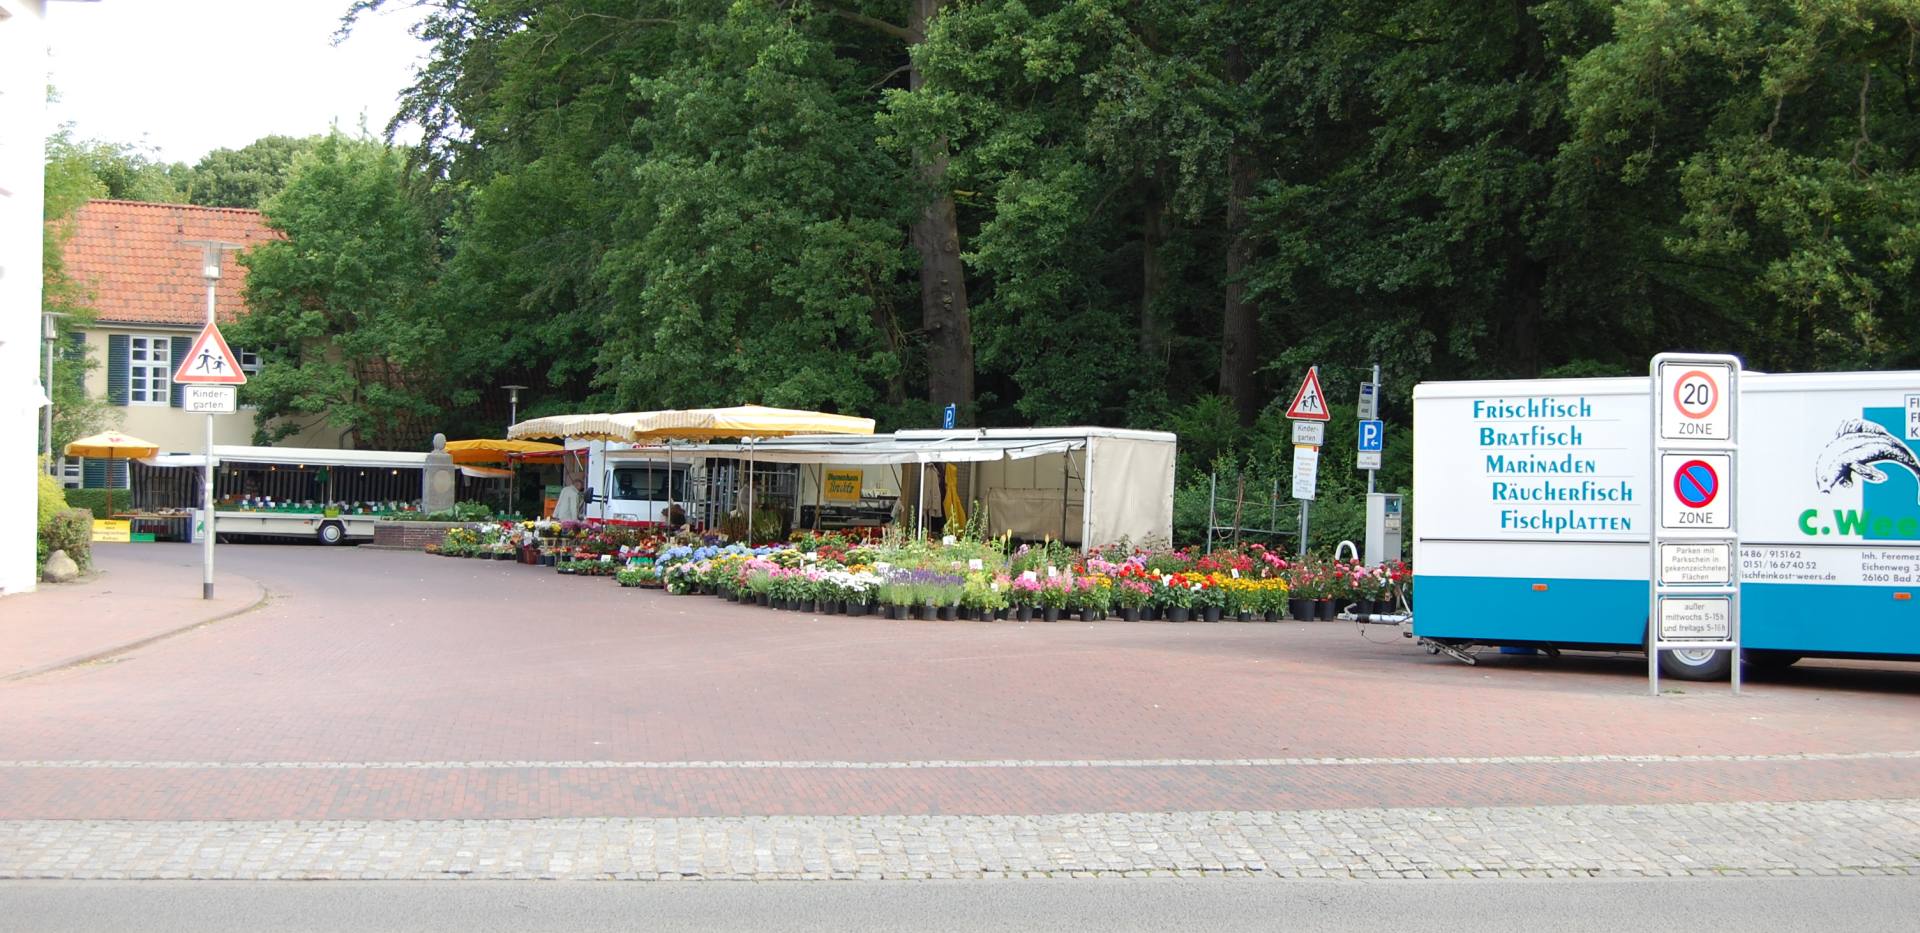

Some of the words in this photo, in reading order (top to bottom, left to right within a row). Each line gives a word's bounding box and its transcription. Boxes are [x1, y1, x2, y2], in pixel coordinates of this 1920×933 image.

[192, 390, 229, 398] Kinder-
[1684, 383, 1709, 405] 20
[193, 401, 224, 410] garten
[1679, 423, 1713, 435] ZONE
[1679, 512, 1713, 524] ZONE
[1741, 571, 1836, 581] ischfeinkost-weers.de
[1862, 574, 1889, 582] 26160
[1893, 574, 1911, 582] Bad
[1664, 624, 1676, 632] und
